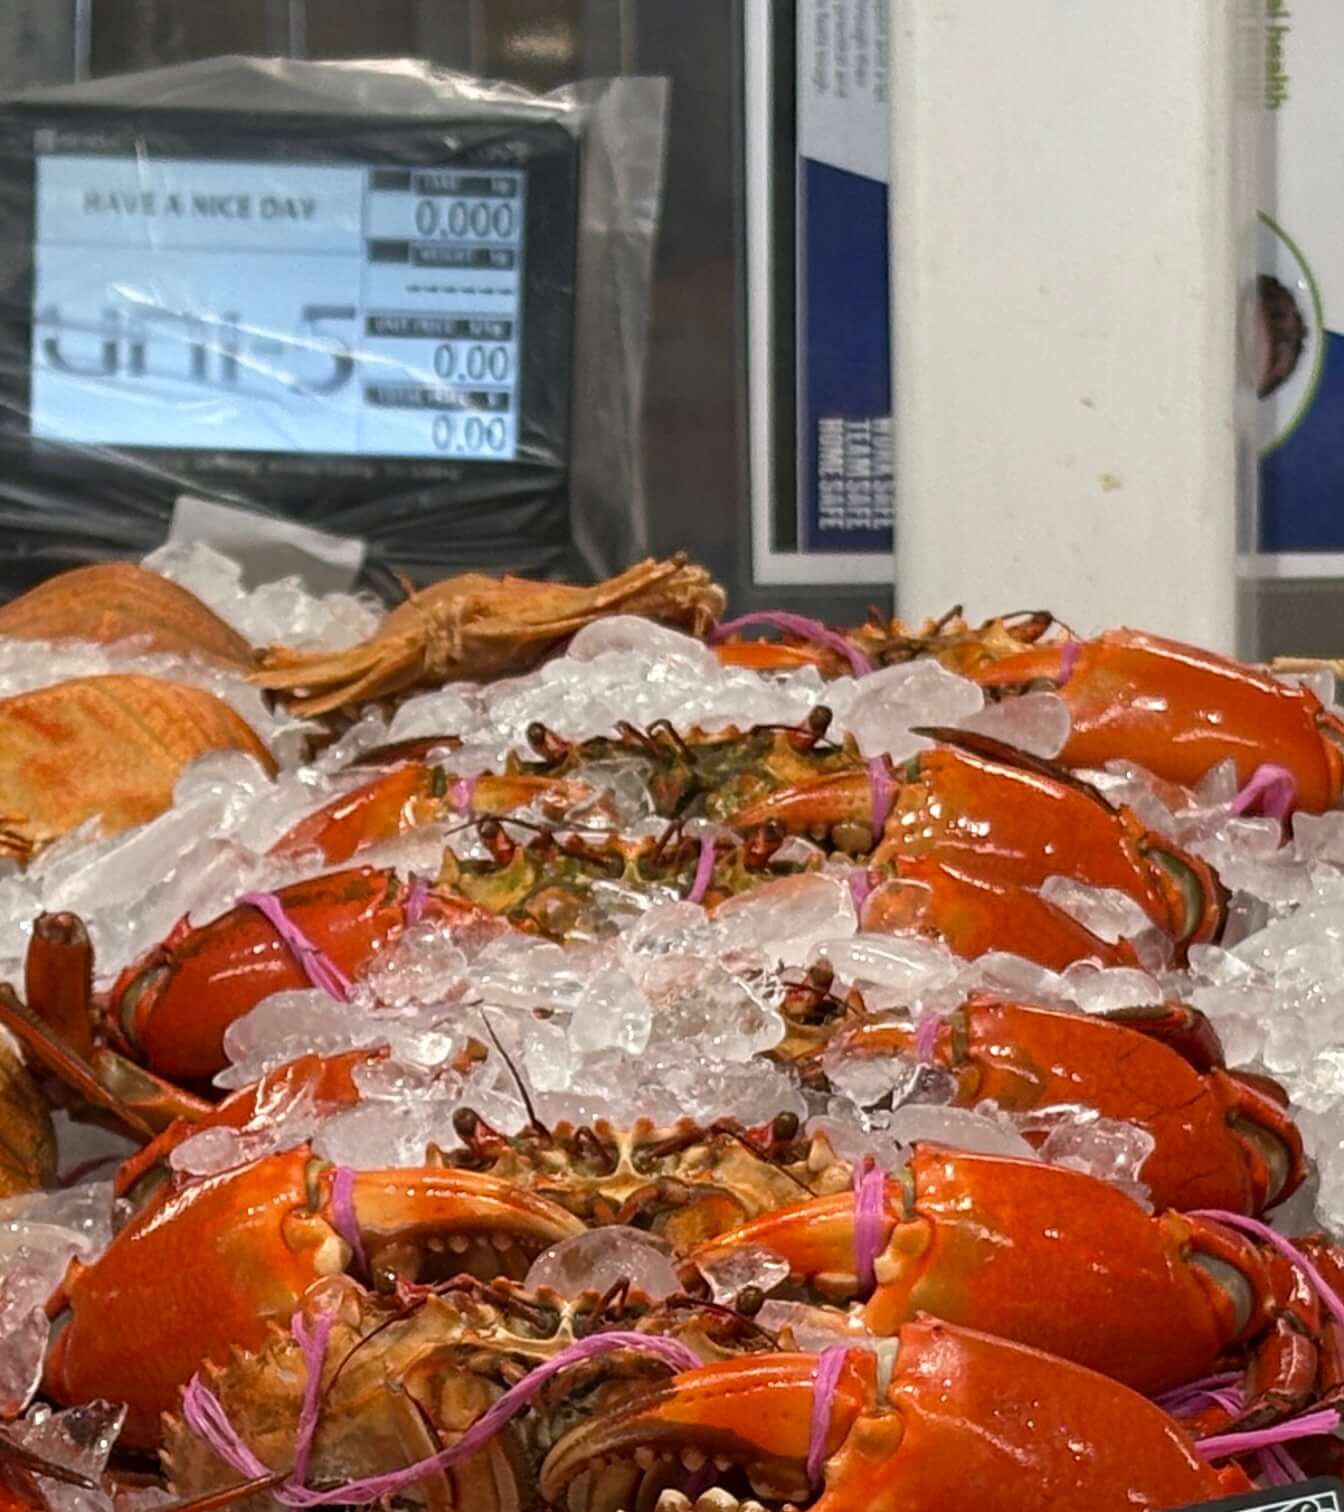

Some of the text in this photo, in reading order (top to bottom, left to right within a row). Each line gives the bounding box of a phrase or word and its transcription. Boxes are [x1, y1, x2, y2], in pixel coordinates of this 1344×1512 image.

[83, 190, 317, 221] HAVE A NICE DAY
[416, 200, 513, 239] 0.000
[434, 344, 508, 382] 0.00
[432, 414, 505, 452] 0.00
[817, 417, 844, 530] HOME SAFE
[845, 417, 871, 530] TEAM SAFE
